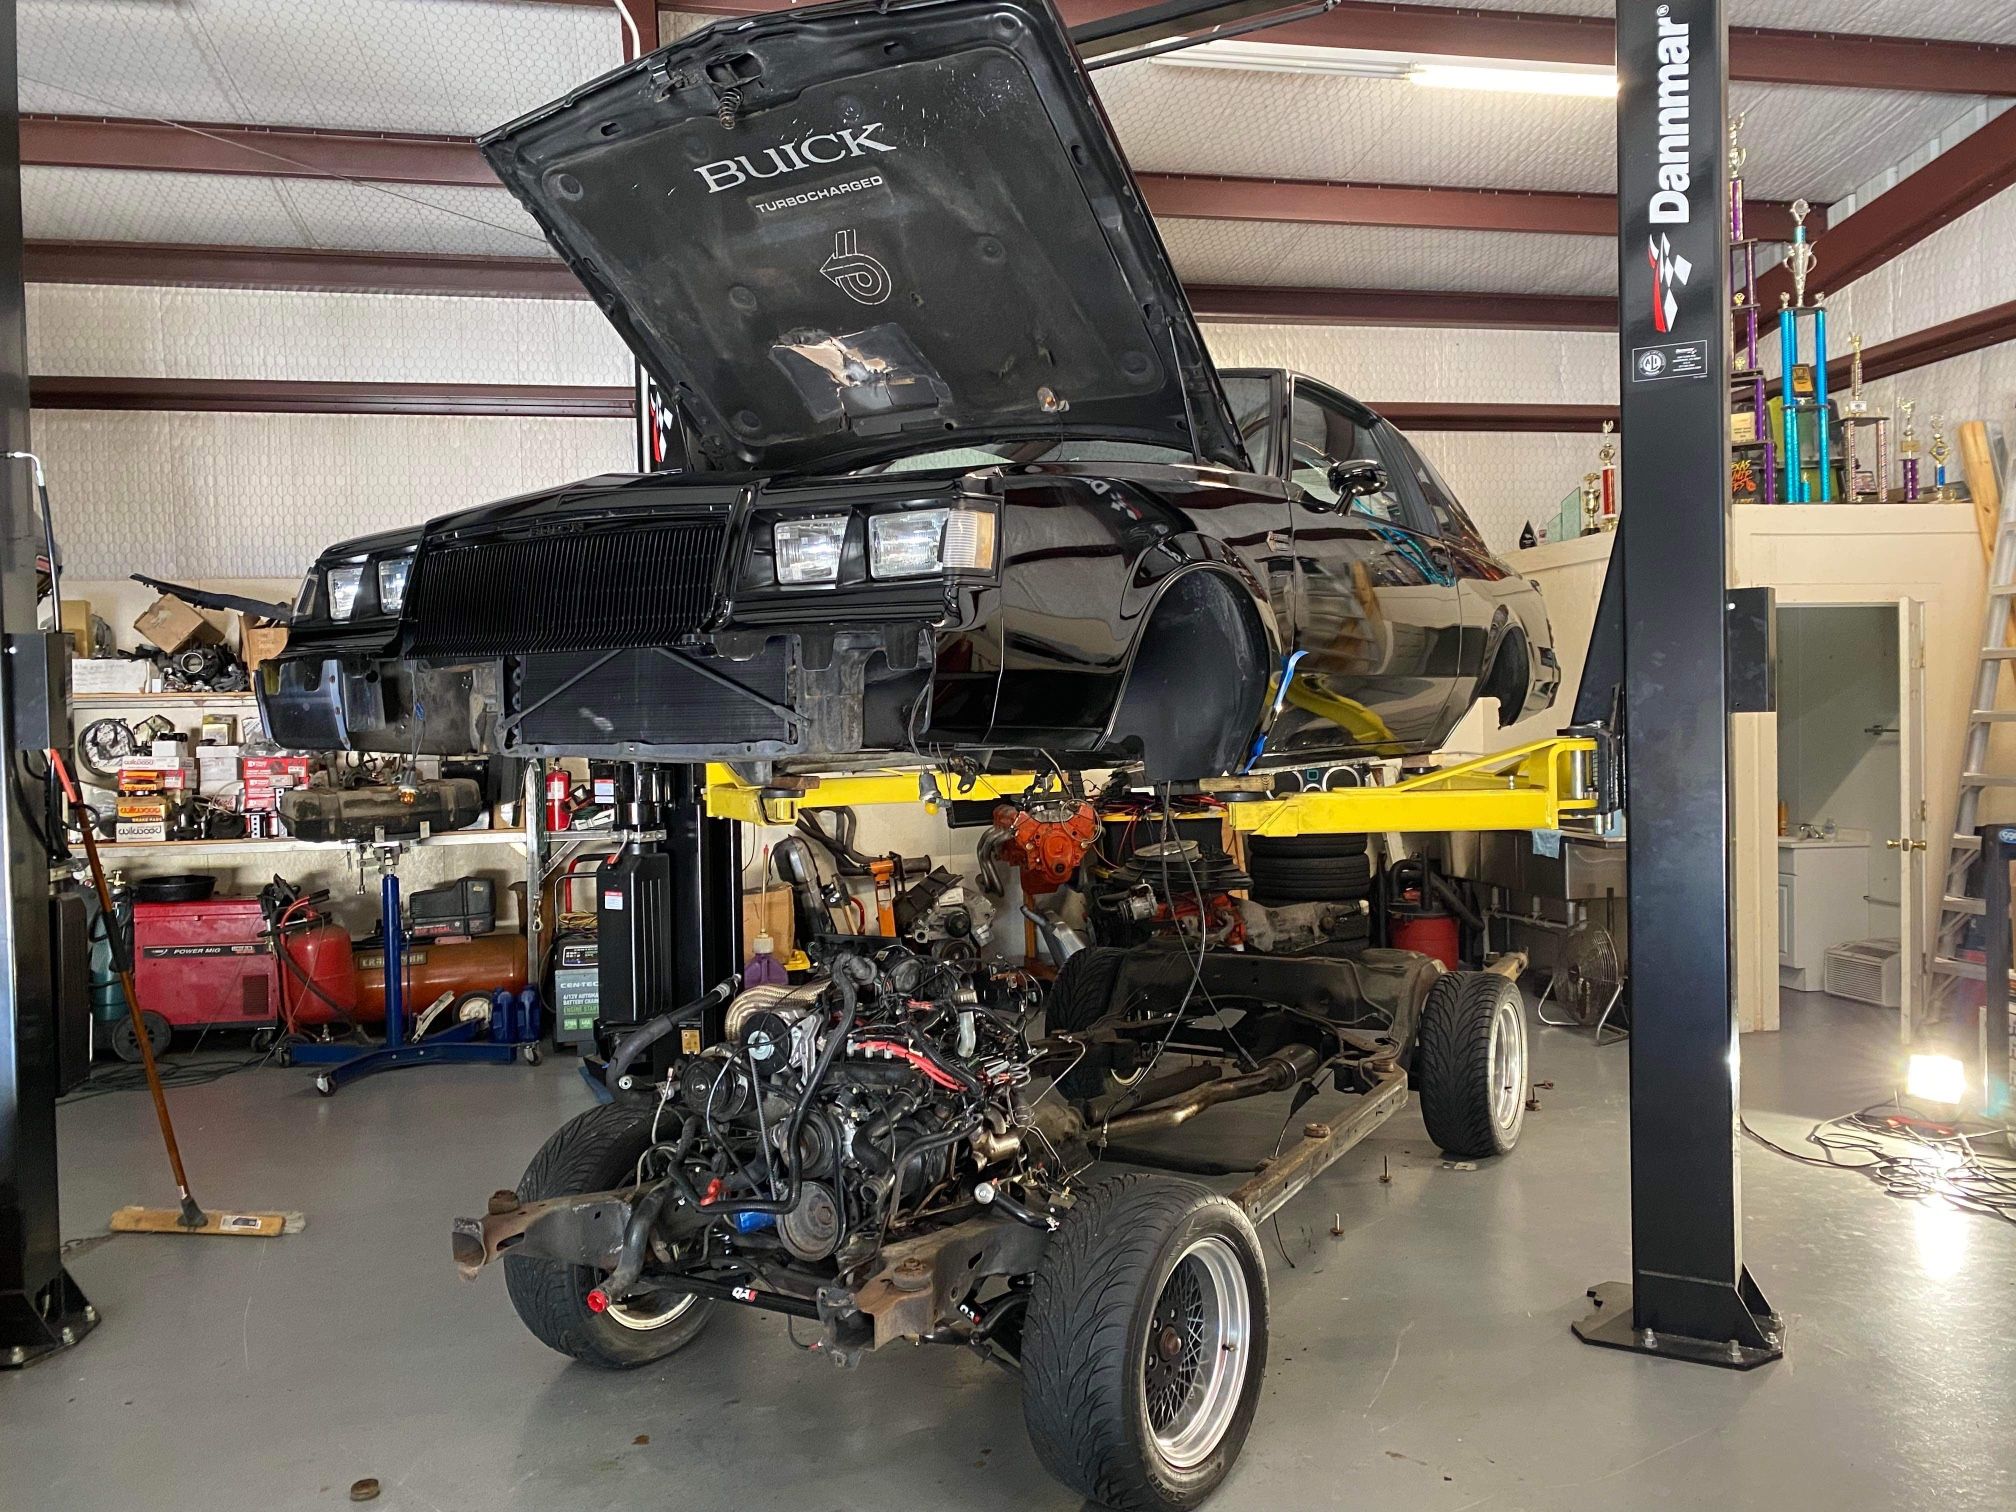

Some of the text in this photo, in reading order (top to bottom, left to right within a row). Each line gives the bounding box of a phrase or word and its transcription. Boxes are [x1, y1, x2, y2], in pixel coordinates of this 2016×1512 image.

[693, 122, 897, 194] BUICK
[755, 175, 883, 213] TURBOCHARGED
[120, 805, 161, 814] wilwood
[118, 825, 162, 836] wilwood
